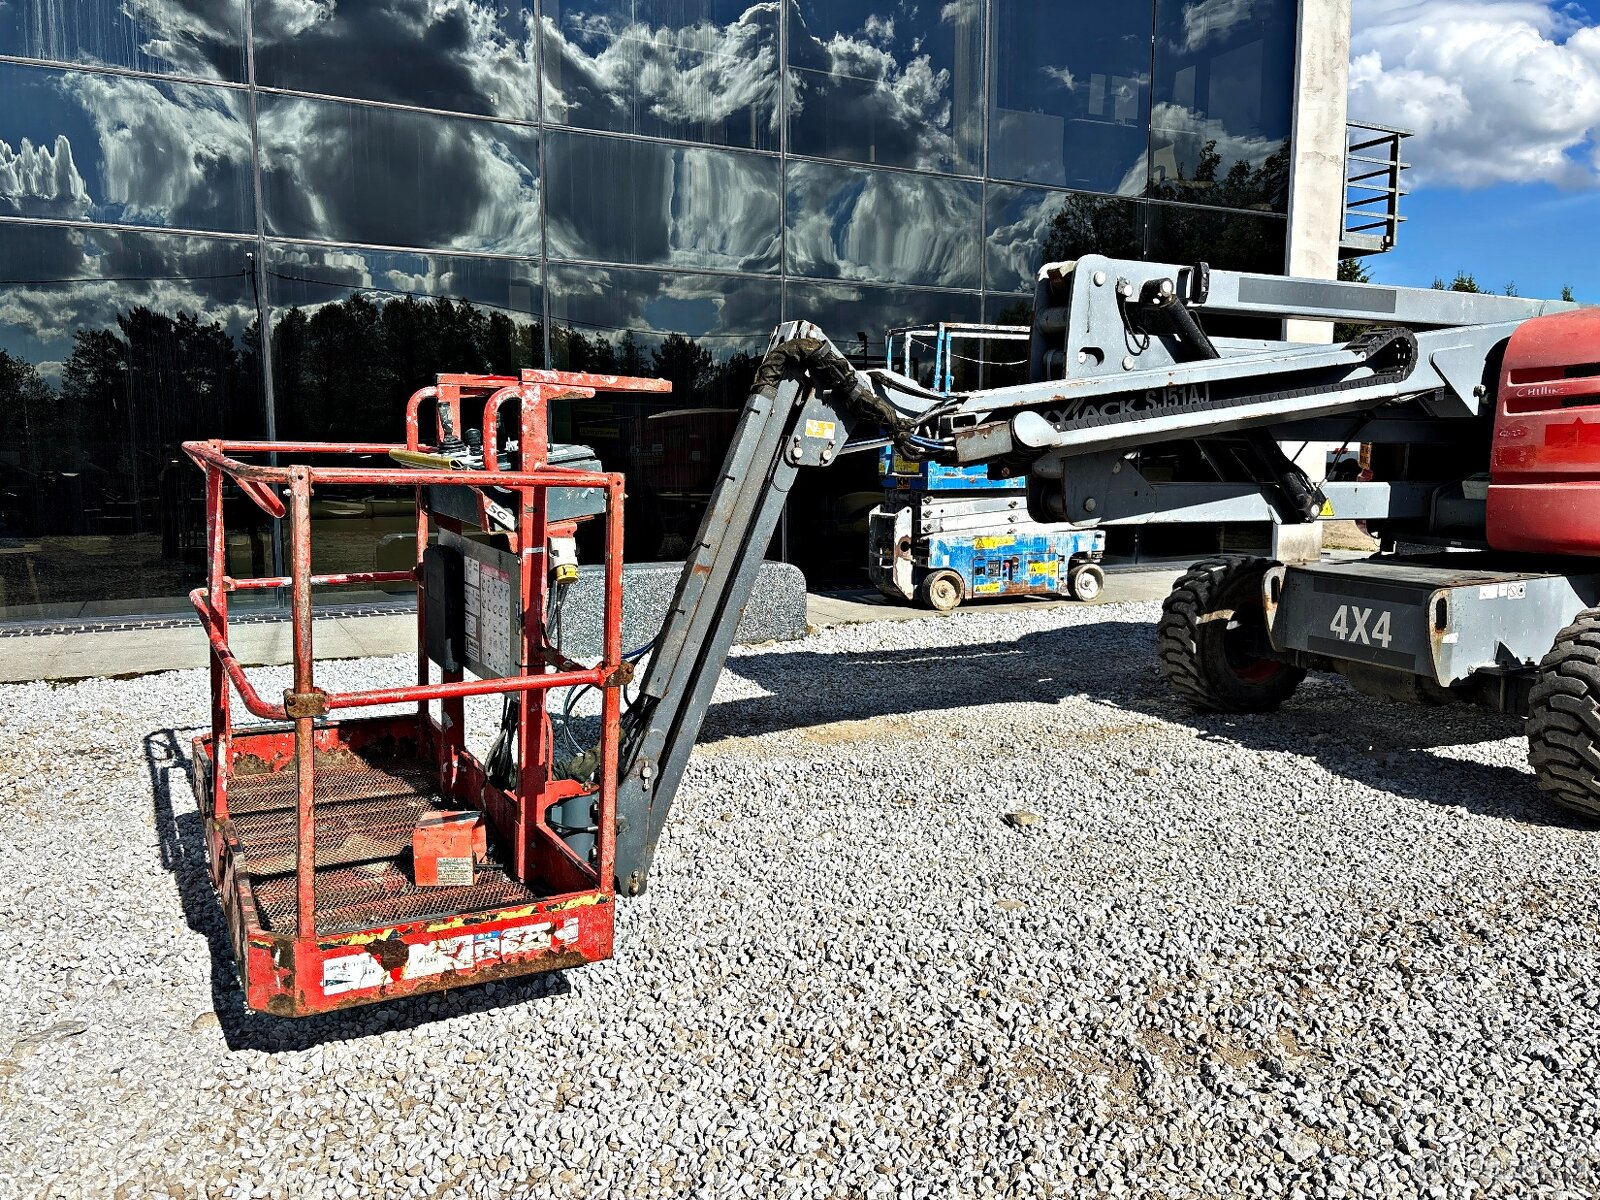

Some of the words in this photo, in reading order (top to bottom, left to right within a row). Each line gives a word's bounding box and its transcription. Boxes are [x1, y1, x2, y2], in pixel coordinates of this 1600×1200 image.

[1145, 382, 1210, 411] SJ51AJ
[489, 504, 508, 521] SG
[1329, 604, 1393, 648] 4X4
